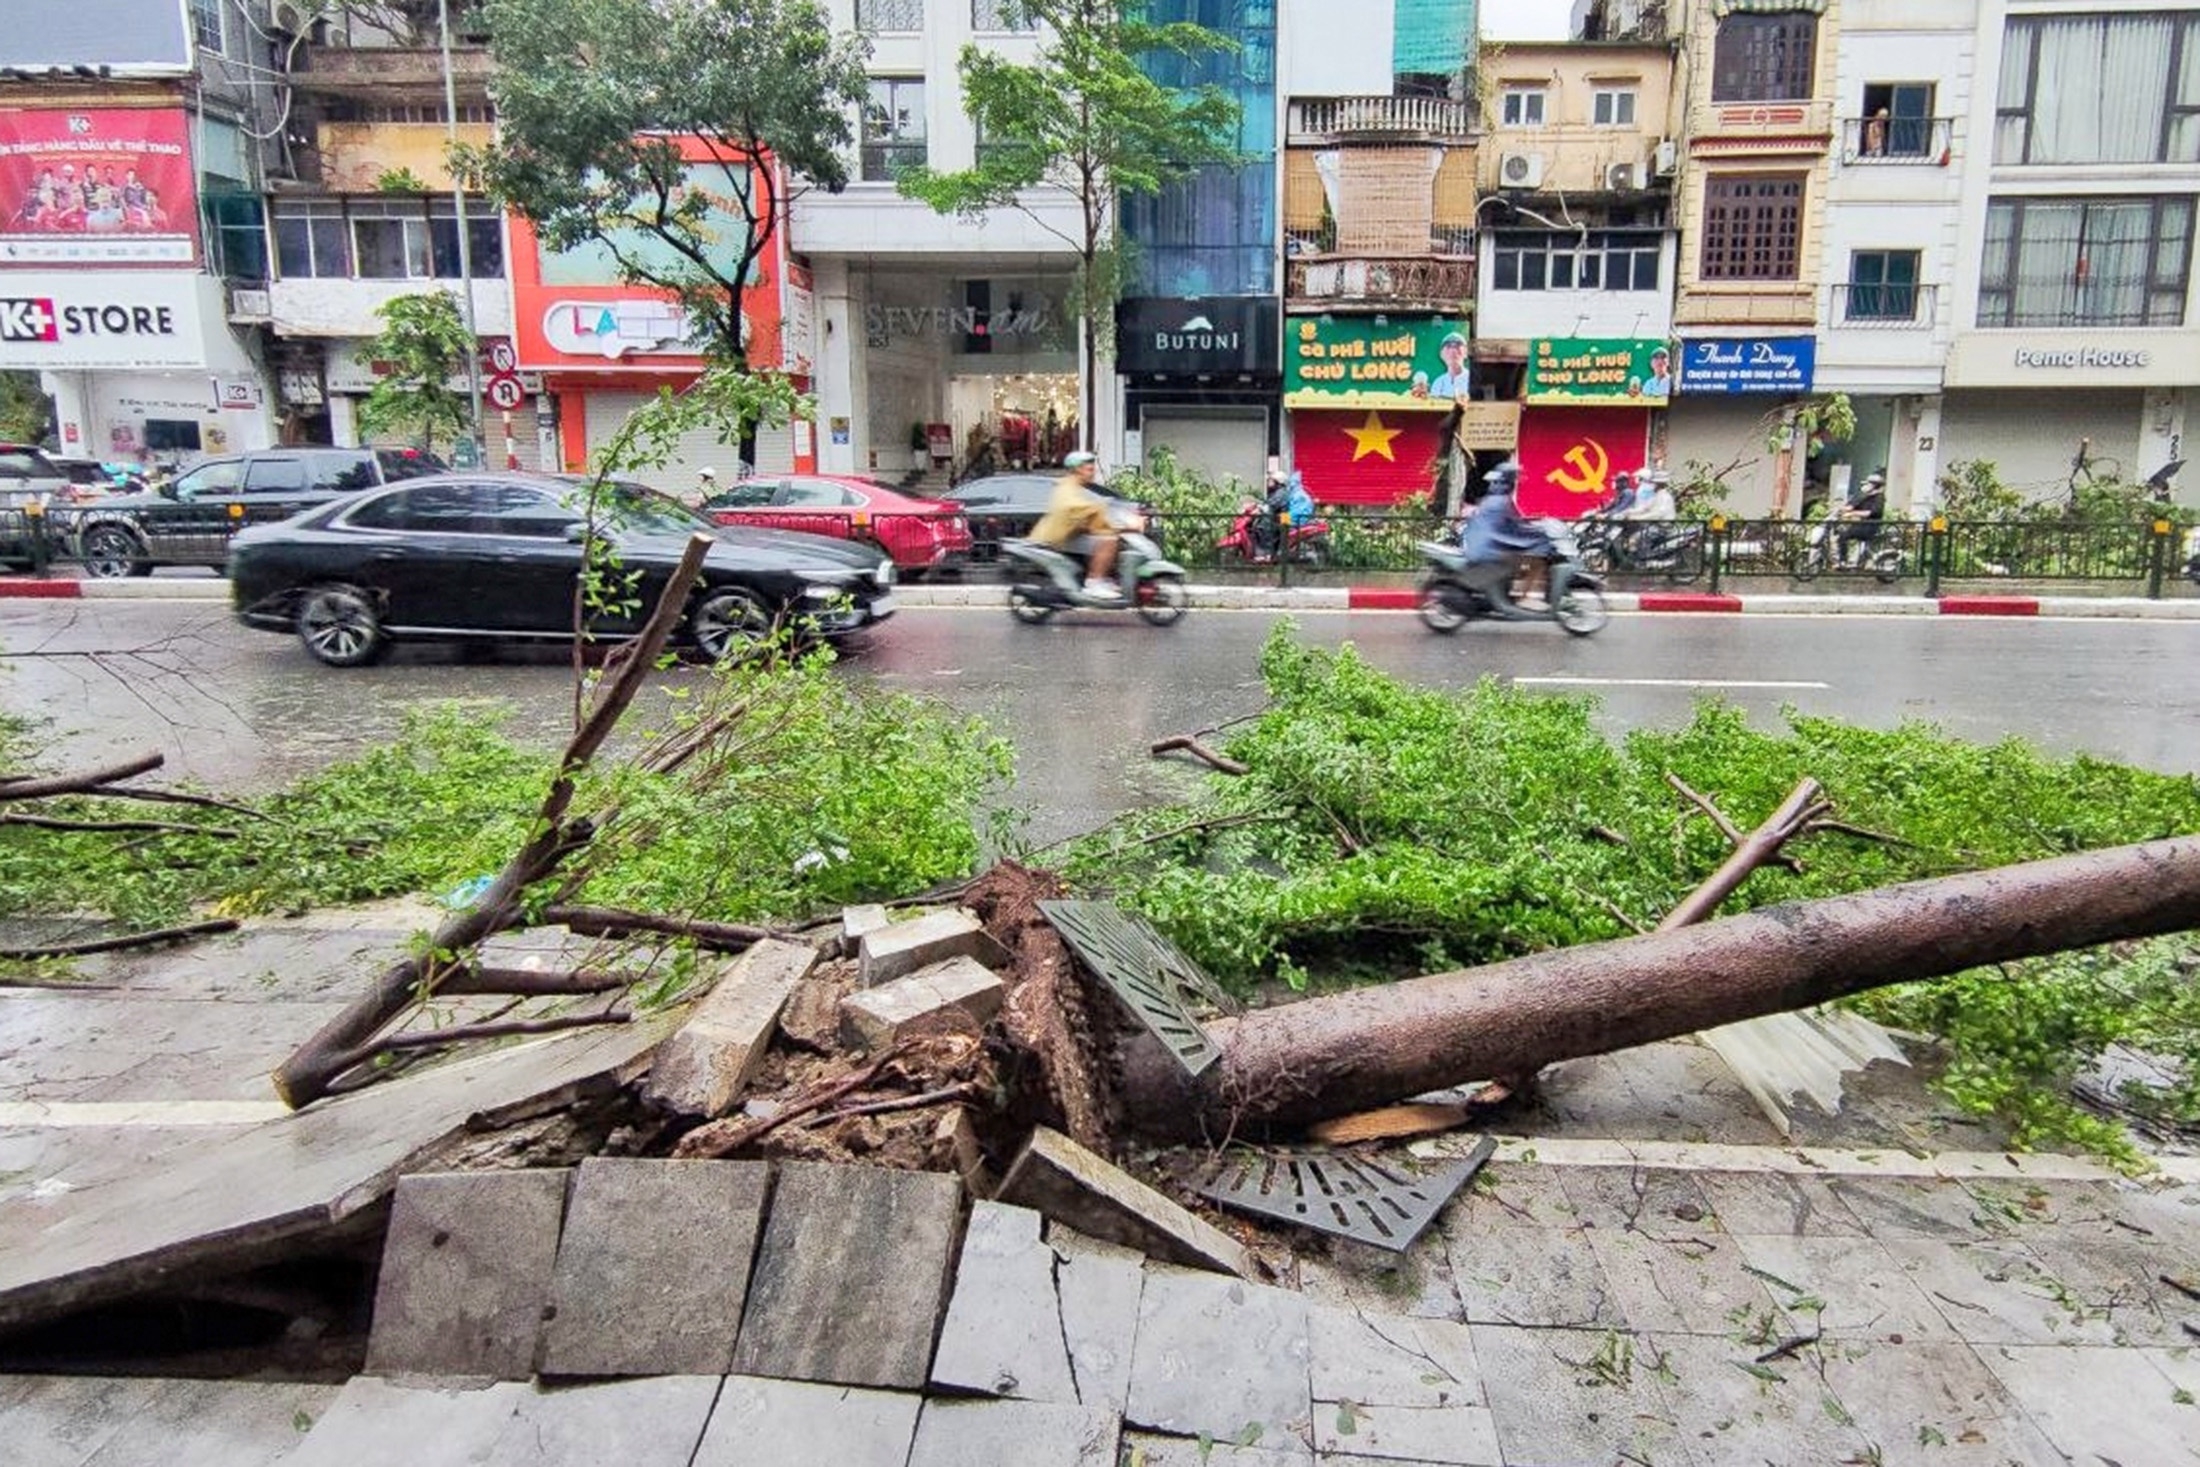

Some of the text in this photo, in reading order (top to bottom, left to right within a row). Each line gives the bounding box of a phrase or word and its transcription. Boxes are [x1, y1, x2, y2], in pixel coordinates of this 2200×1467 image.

[65, 305, 174, 334] STORE
[1156, 332, 1238, 350] BUTUNI
[1695, 343, 1743, 363] Thanh
[2080, 348, 2150, 367] House
[1351, 361, 1411, 380] LONG
[1578, 370, 1626, 384] LONG
[1919, 436, 1934, 451] 23
